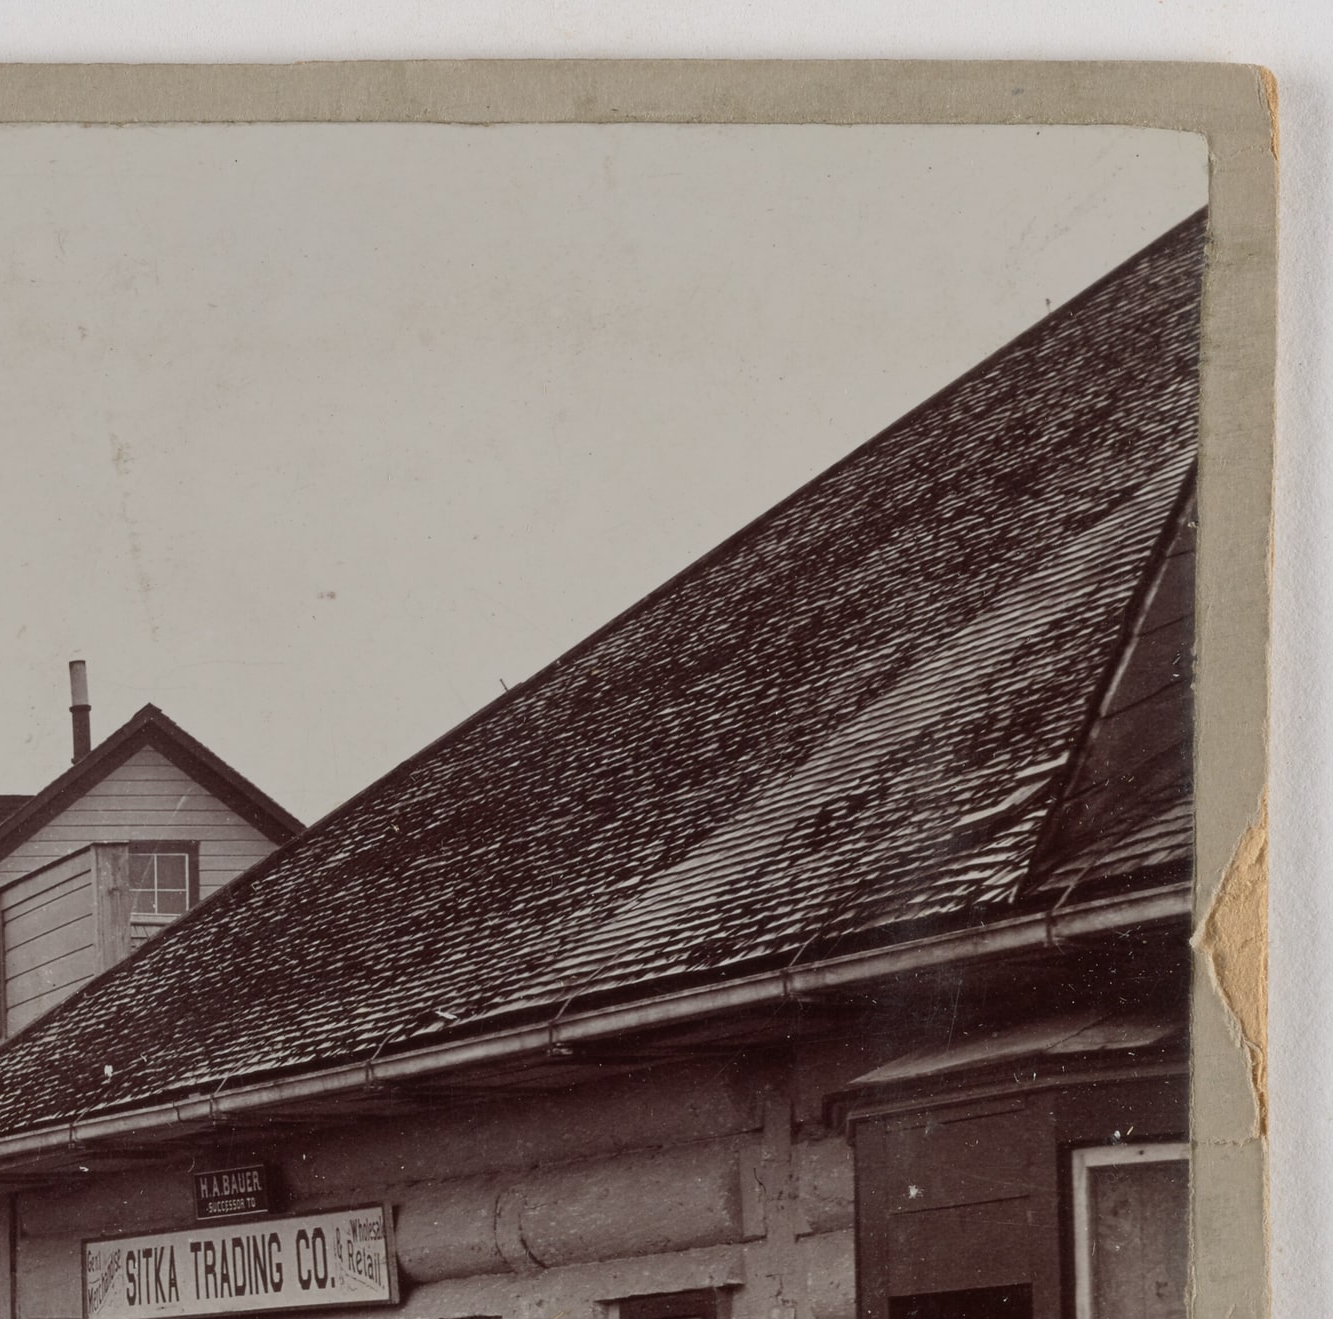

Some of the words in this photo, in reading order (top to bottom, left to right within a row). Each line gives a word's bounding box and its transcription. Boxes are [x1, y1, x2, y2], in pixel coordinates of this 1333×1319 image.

[125, 1245, 180, 1306] SITKA
[190, 1232, 283, 1300] TRADING
[295, 1226, 336, 1290] CO.
